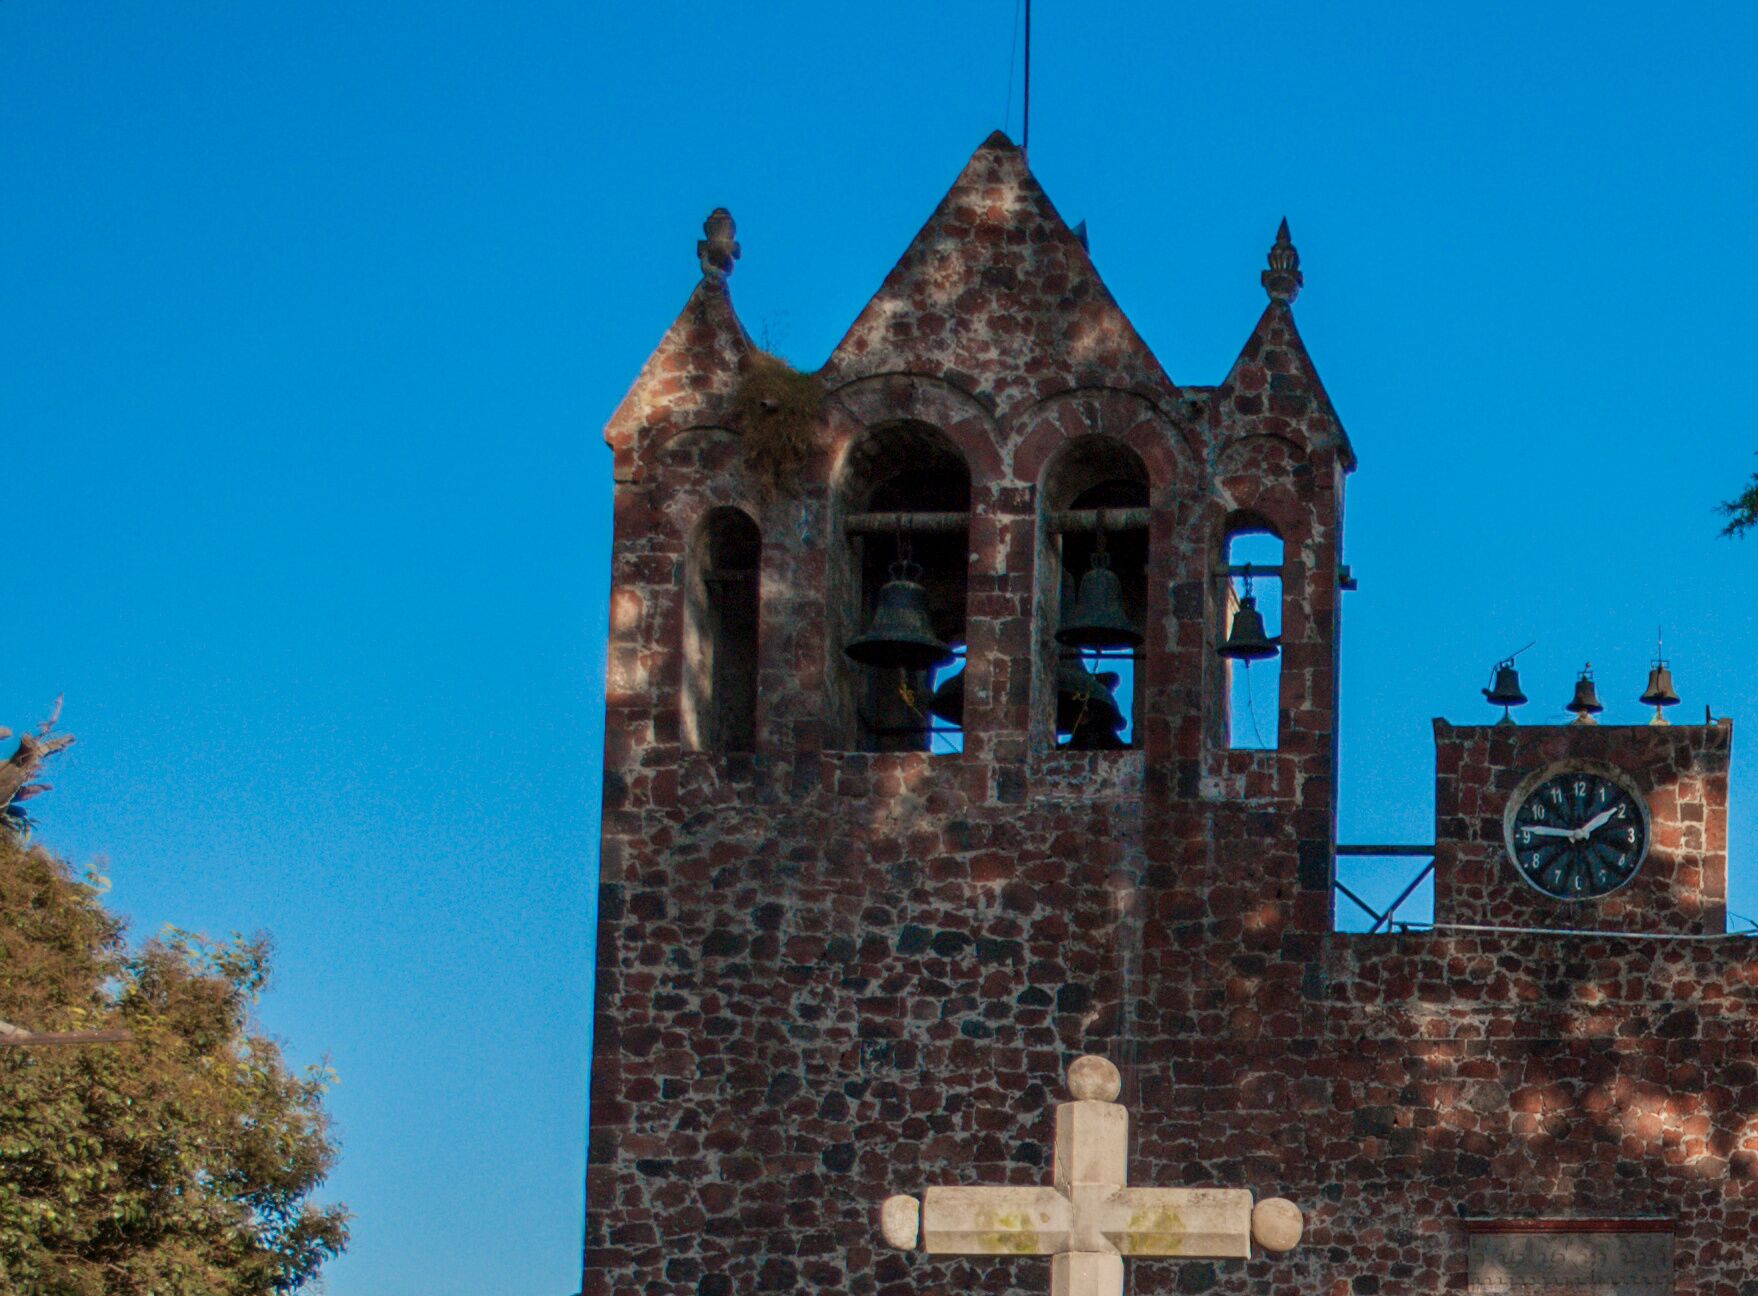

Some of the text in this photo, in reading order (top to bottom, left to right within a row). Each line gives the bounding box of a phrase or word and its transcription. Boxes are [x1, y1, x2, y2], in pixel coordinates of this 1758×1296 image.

[1551, 787, 1563, 804] 11
[1573, 781, 1587, 797] 12
[1599, 787, 1606, 802] 1
[1532, 804, 1545, 820] 10
[1617, 803, 1626, 819] 2
[1523, 829, 1531, 844] 9
[1627, 827, 1636, 844] 3
[1532, 853, 1540, 869] 8
[1554, 870, 1562, 884] 7
